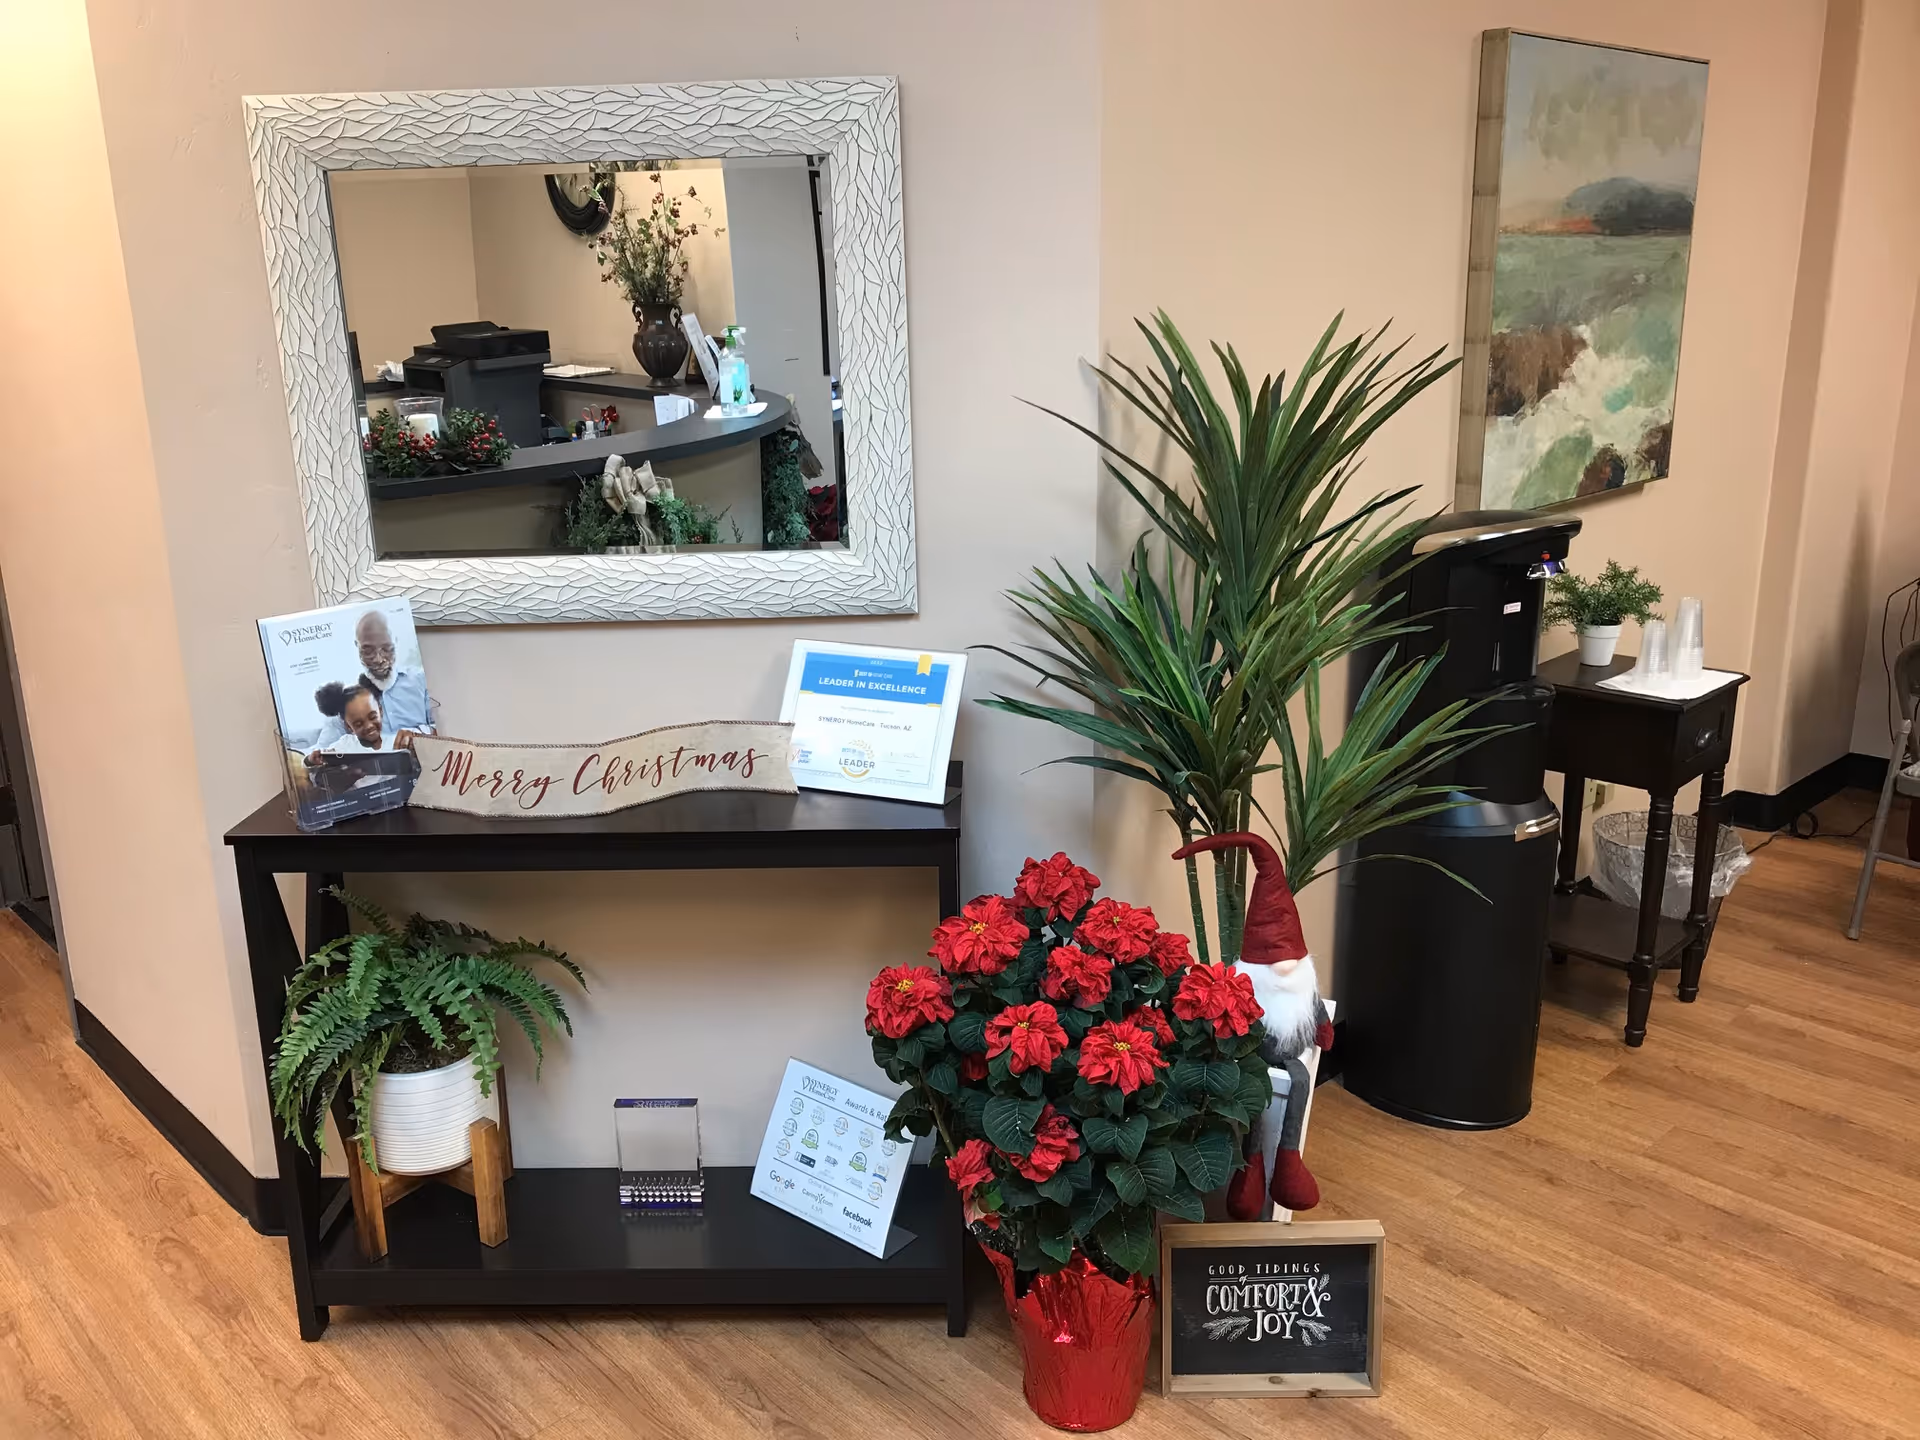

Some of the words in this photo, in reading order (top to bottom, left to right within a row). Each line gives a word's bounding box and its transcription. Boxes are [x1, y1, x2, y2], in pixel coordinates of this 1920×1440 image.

[291, 622, 332, 637] SYNERGY
[294, 631, 333, 645] HomeCare
[819, 677, 854, 688] LEADER
[856, 680, 866, 689] IN
[868, 682, 926, 695] EXCELLENCE
[818, 715, 846, 724] SYNERGY
[847, 718, 875, 727] HomeCare
[838, 757, 876, 770] LEADER
[432, 749, 564, 810] Merry
[572, 745, 769, 797] Christmas
[845, 1099, 869, 1114] Awards
[869, 1108, 876, 1118] &
[875, 1110, 888, 1122] Rat
[769, 1170, 795, 1190] Google
[842, 1206, 872, 1227] facebook
[1208, 1265, 1245, 1275] GOOD
[1256, 1263, 1320, 1274] TIDINGS
[1239, 1275, 1248, 1285] of
[1206, 1282, 1307, 1316] COMFORT
[1302, 1277, 1331, 1318] &
[1247, 1309, 1299, 1343] JOY
